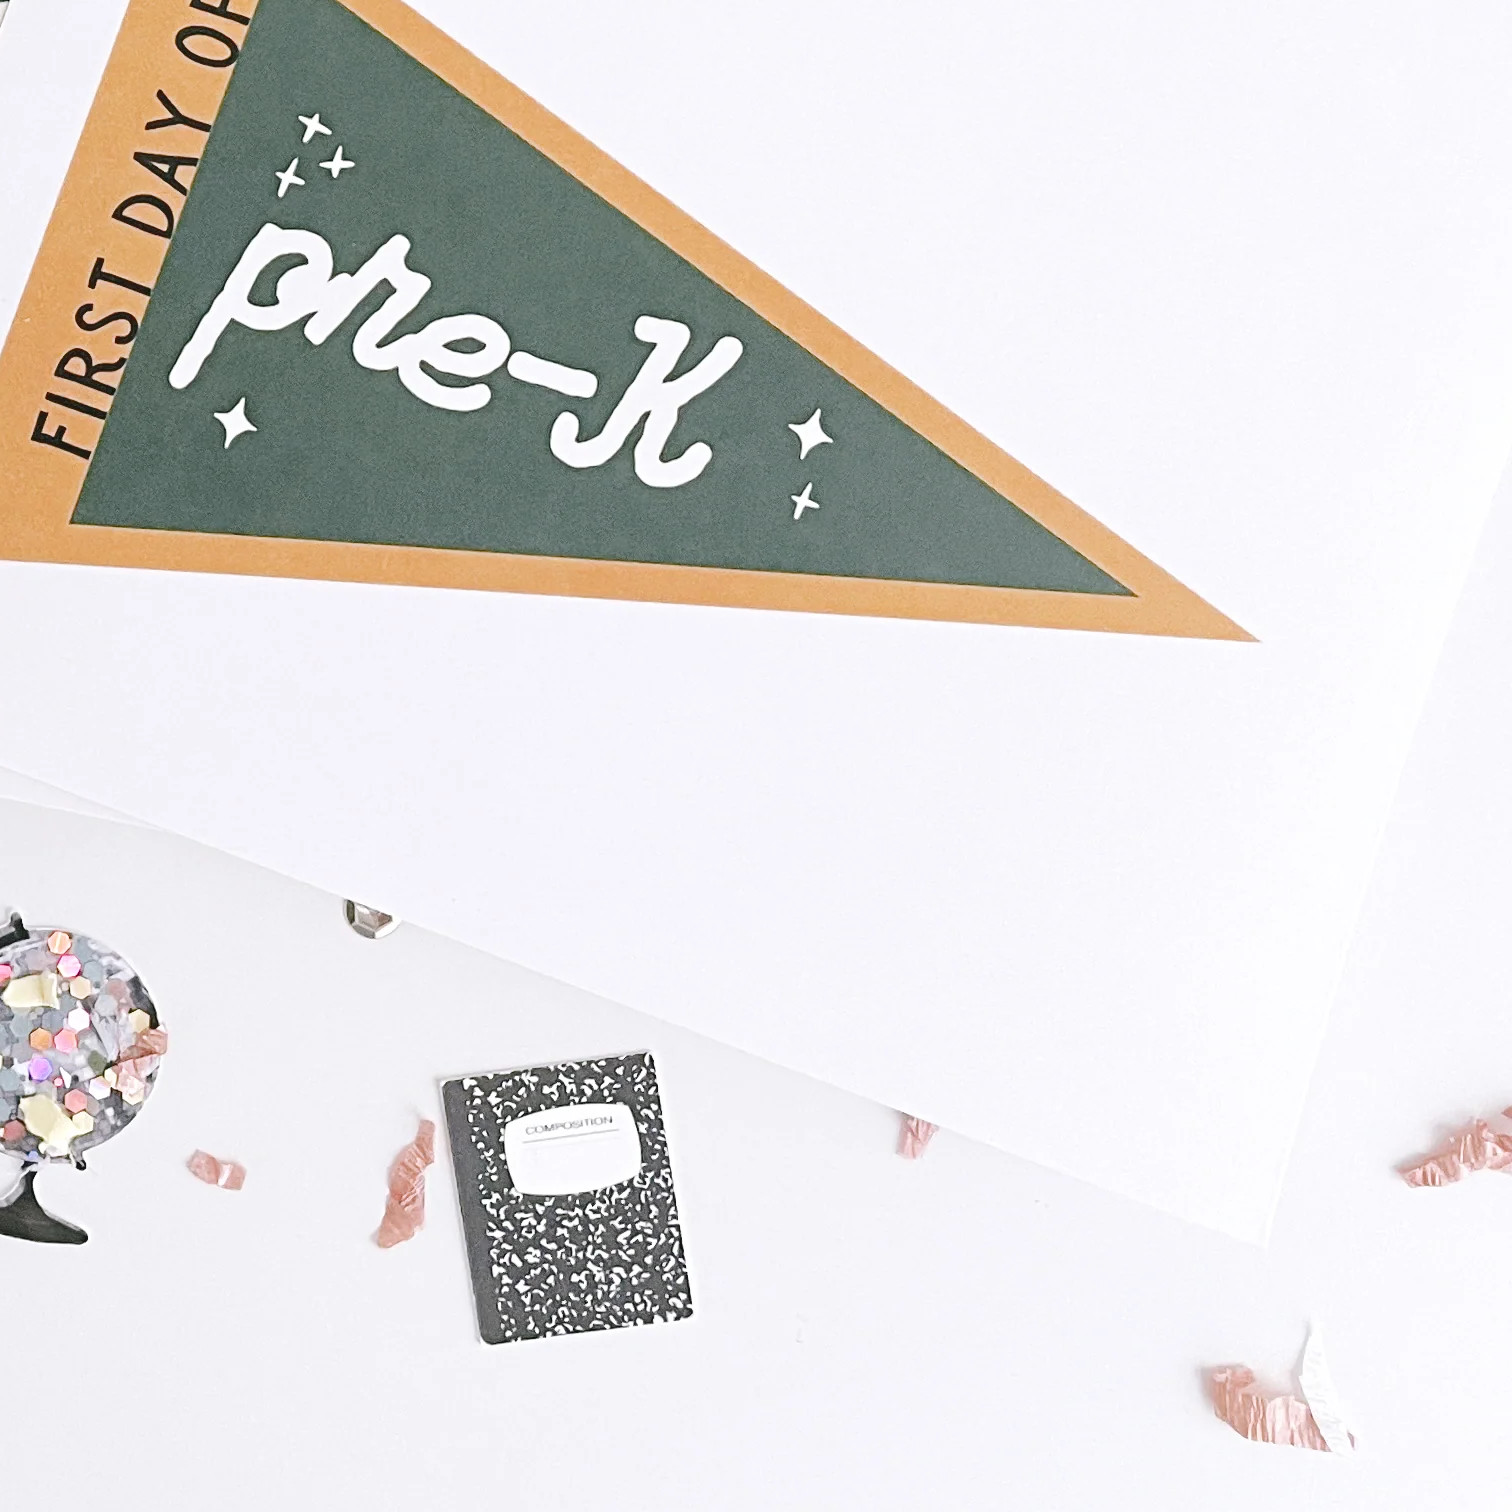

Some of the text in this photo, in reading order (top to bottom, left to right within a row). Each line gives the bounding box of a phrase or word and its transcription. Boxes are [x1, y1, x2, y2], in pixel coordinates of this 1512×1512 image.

[30, 258, 150, 461] FIRST
[111, 89, 211, 239] DAY
[525, 1116, 613, 1135] COMPOSITION
